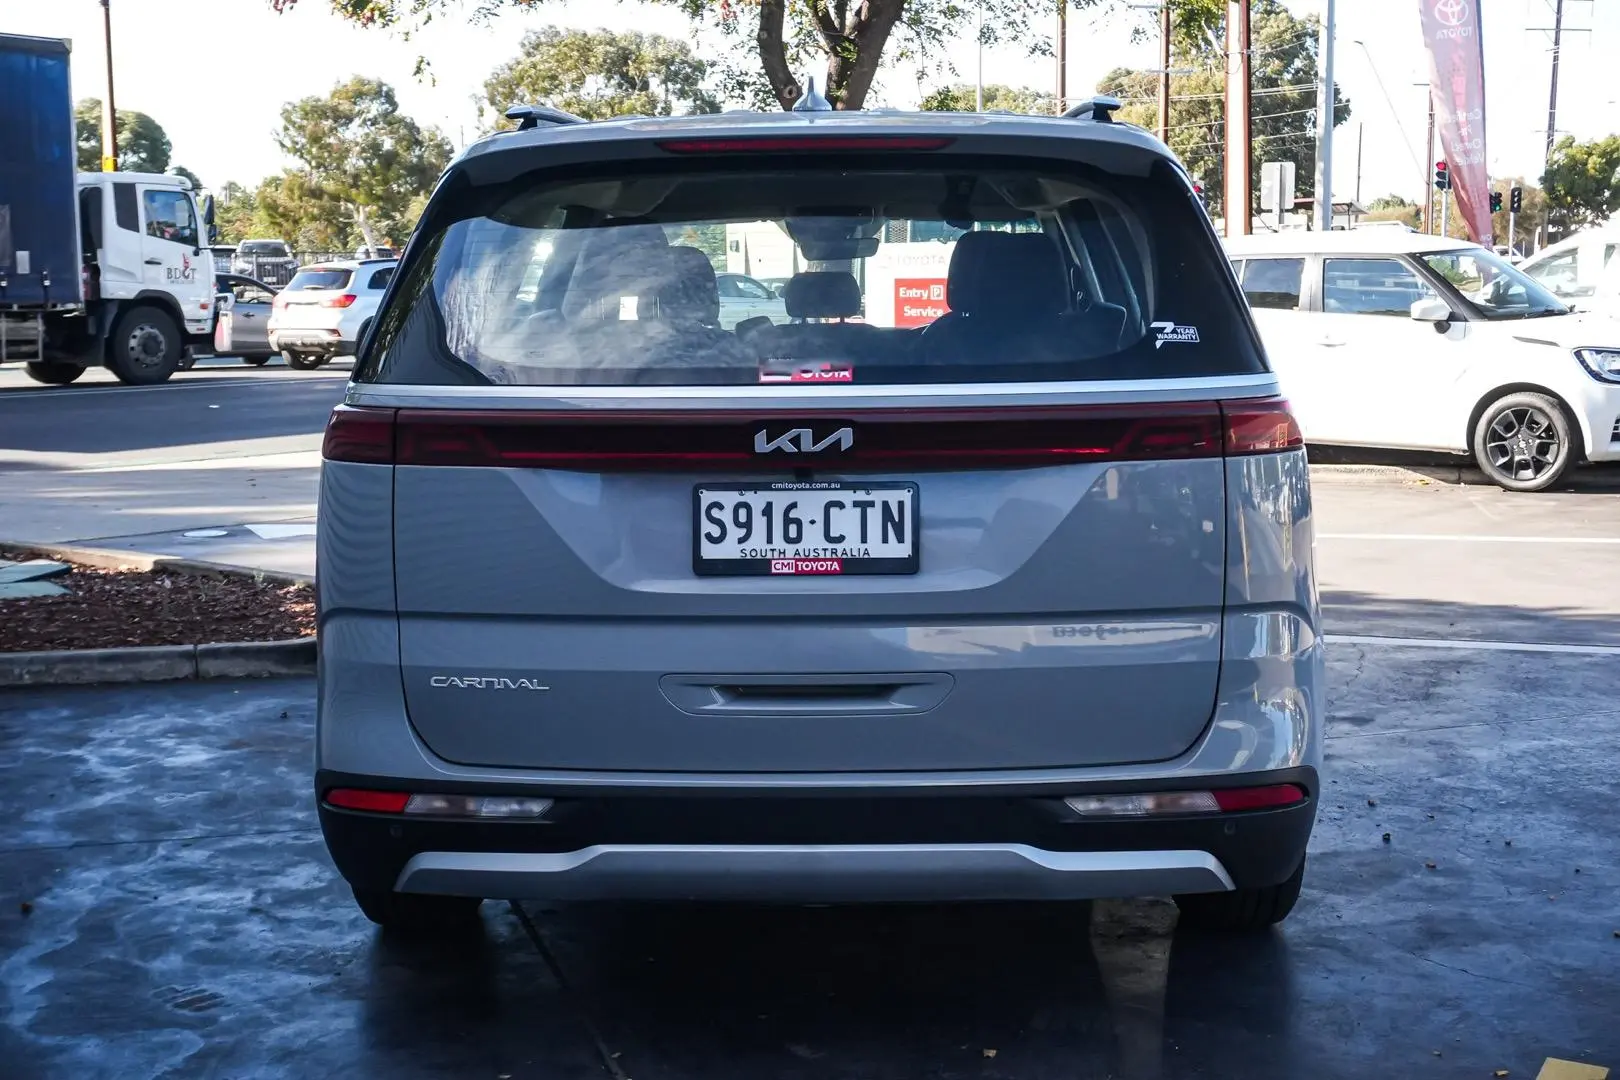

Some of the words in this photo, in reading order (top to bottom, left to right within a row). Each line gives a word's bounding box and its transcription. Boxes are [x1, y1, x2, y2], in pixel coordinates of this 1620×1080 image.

[899, 287, 928, 300] Entry
[903, 305, 944, 317] Service
[754, 427, 853, 453] KIA
[771, 482, 841, 490] cmitoyota.com.au
[740, 548, 786, 558] SOUTH
[793, 547, 870, 558] AUSTRALIA
[773, 561, 794, 571] CMI
[797, 561, 840, 571] TOYOTA
[430, 676, 550, 690] CARNIVAL
